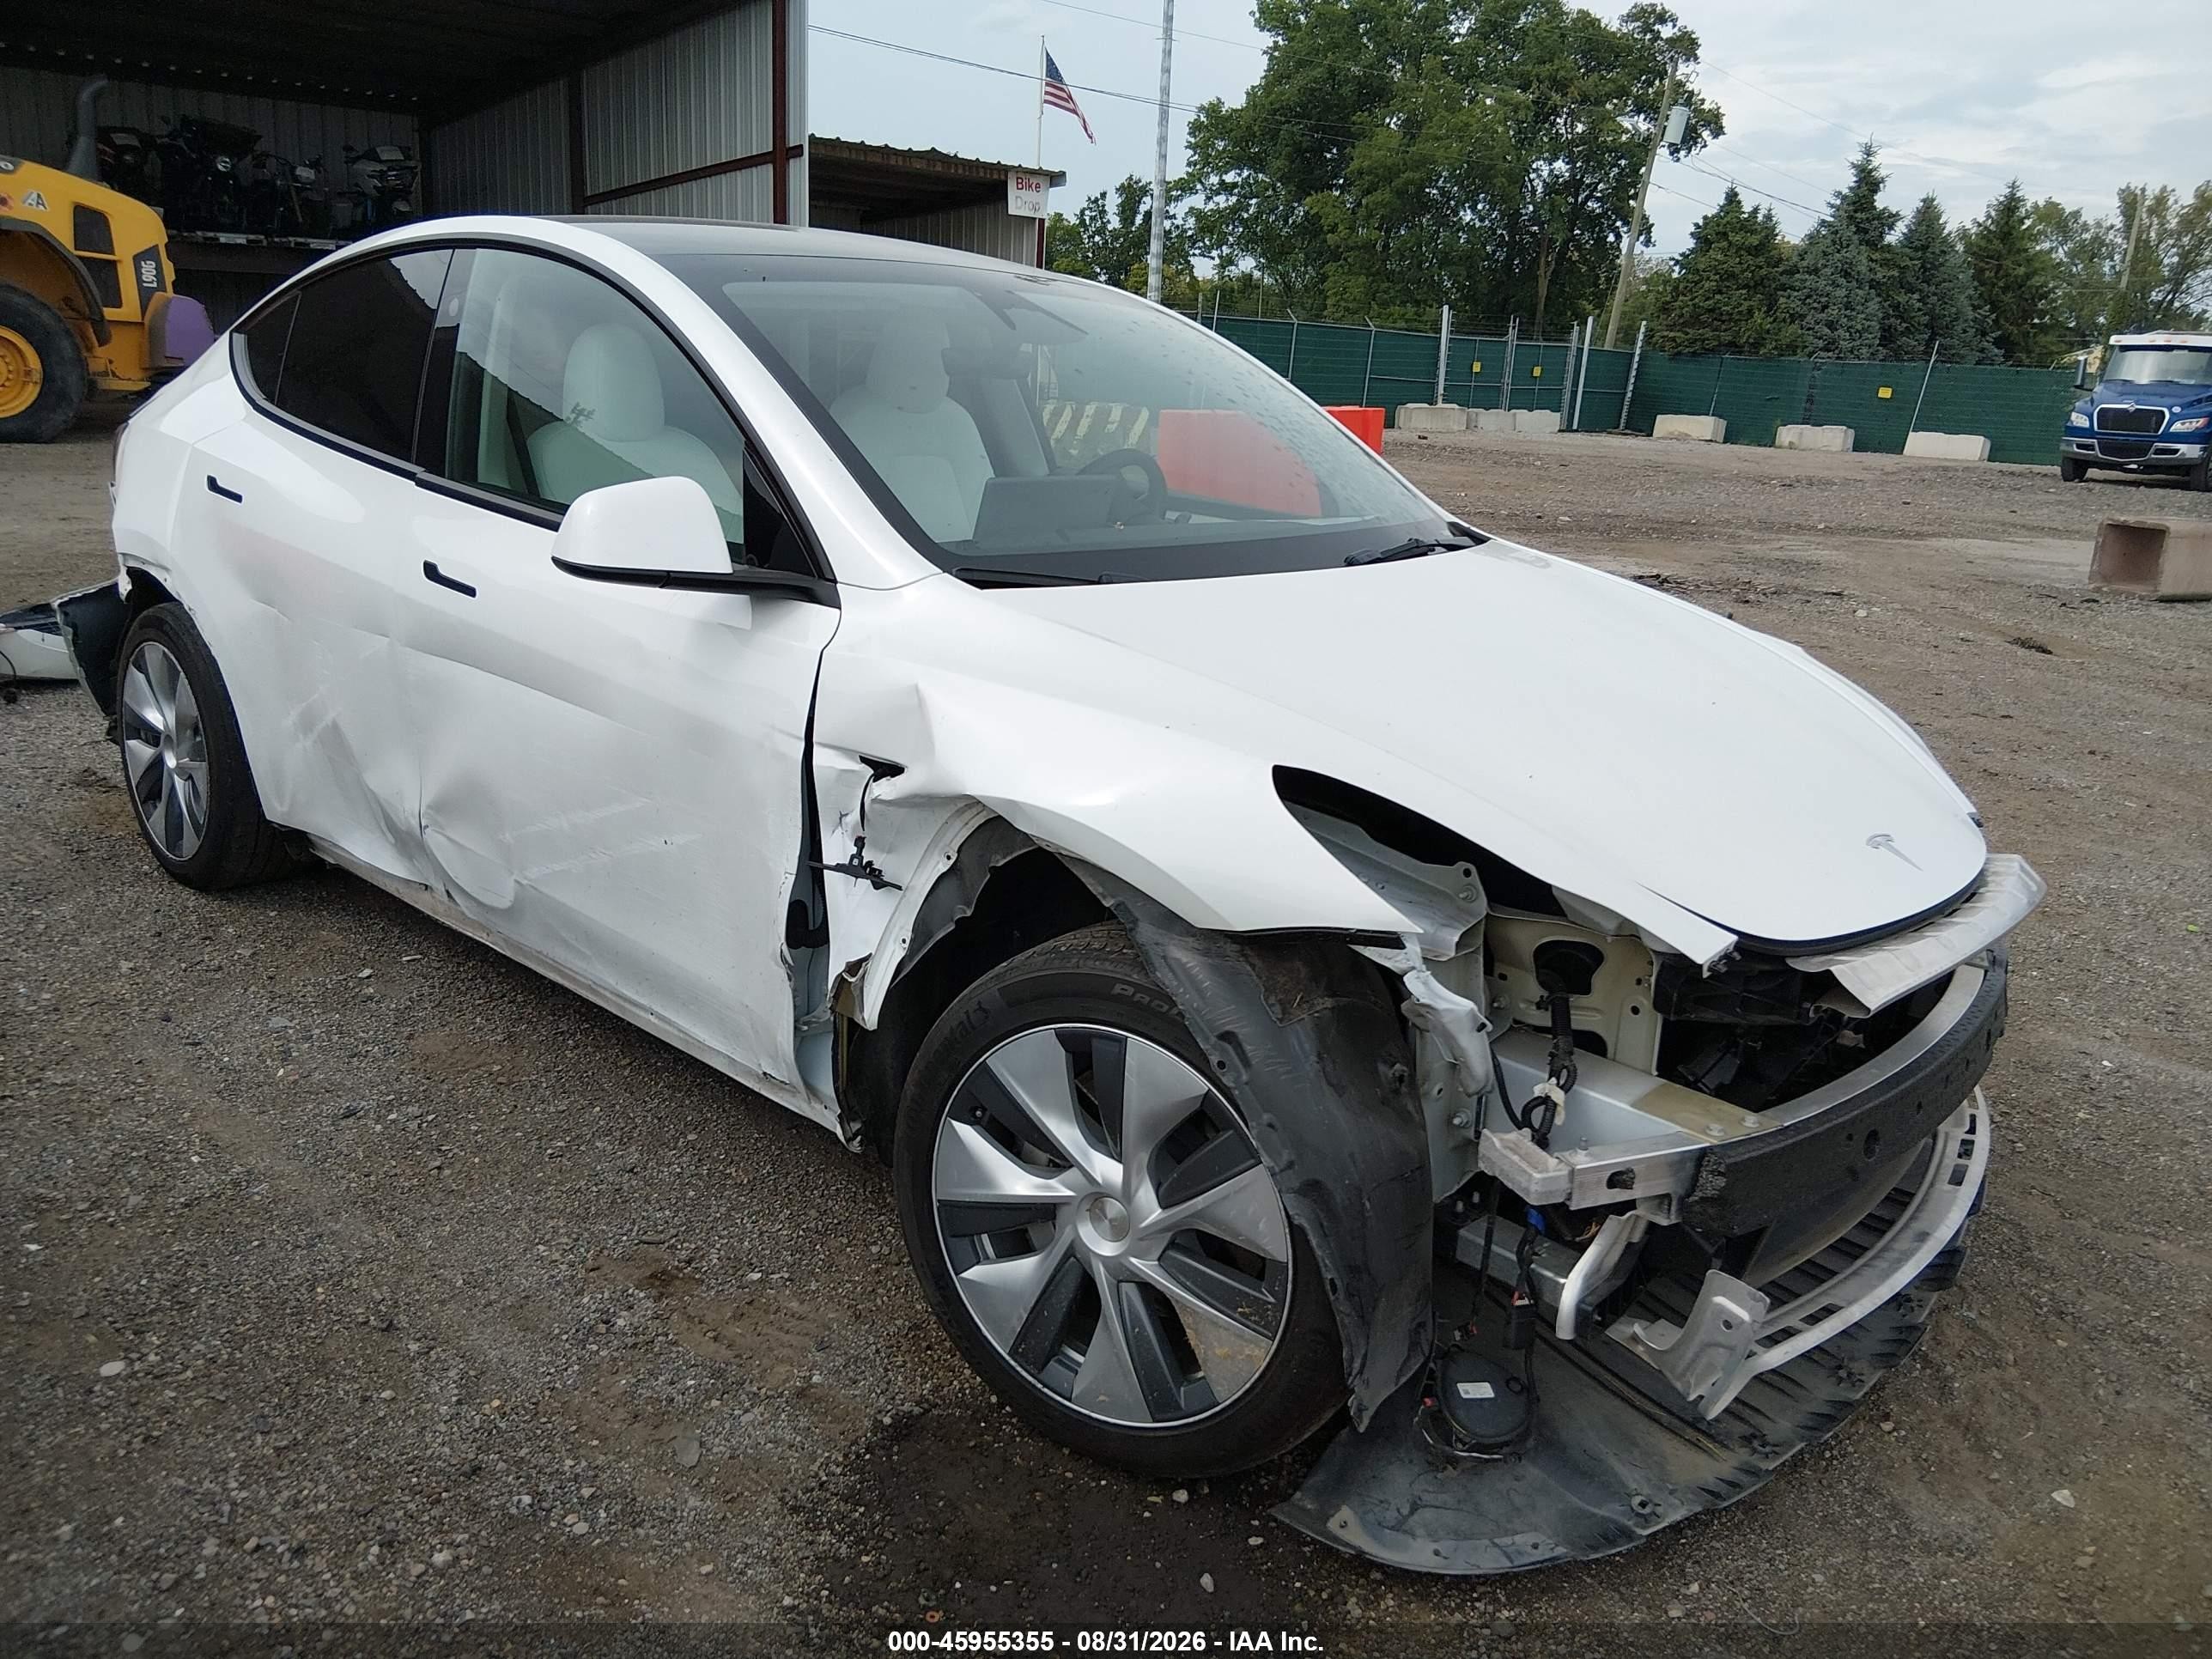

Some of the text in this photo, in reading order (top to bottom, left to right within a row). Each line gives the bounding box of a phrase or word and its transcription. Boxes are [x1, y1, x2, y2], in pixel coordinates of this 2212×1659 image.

[1016, 177, 1042, 193] Bike
[1015, 196, 1041, 214] Drop
[140, 260, 158, 289] L90G
